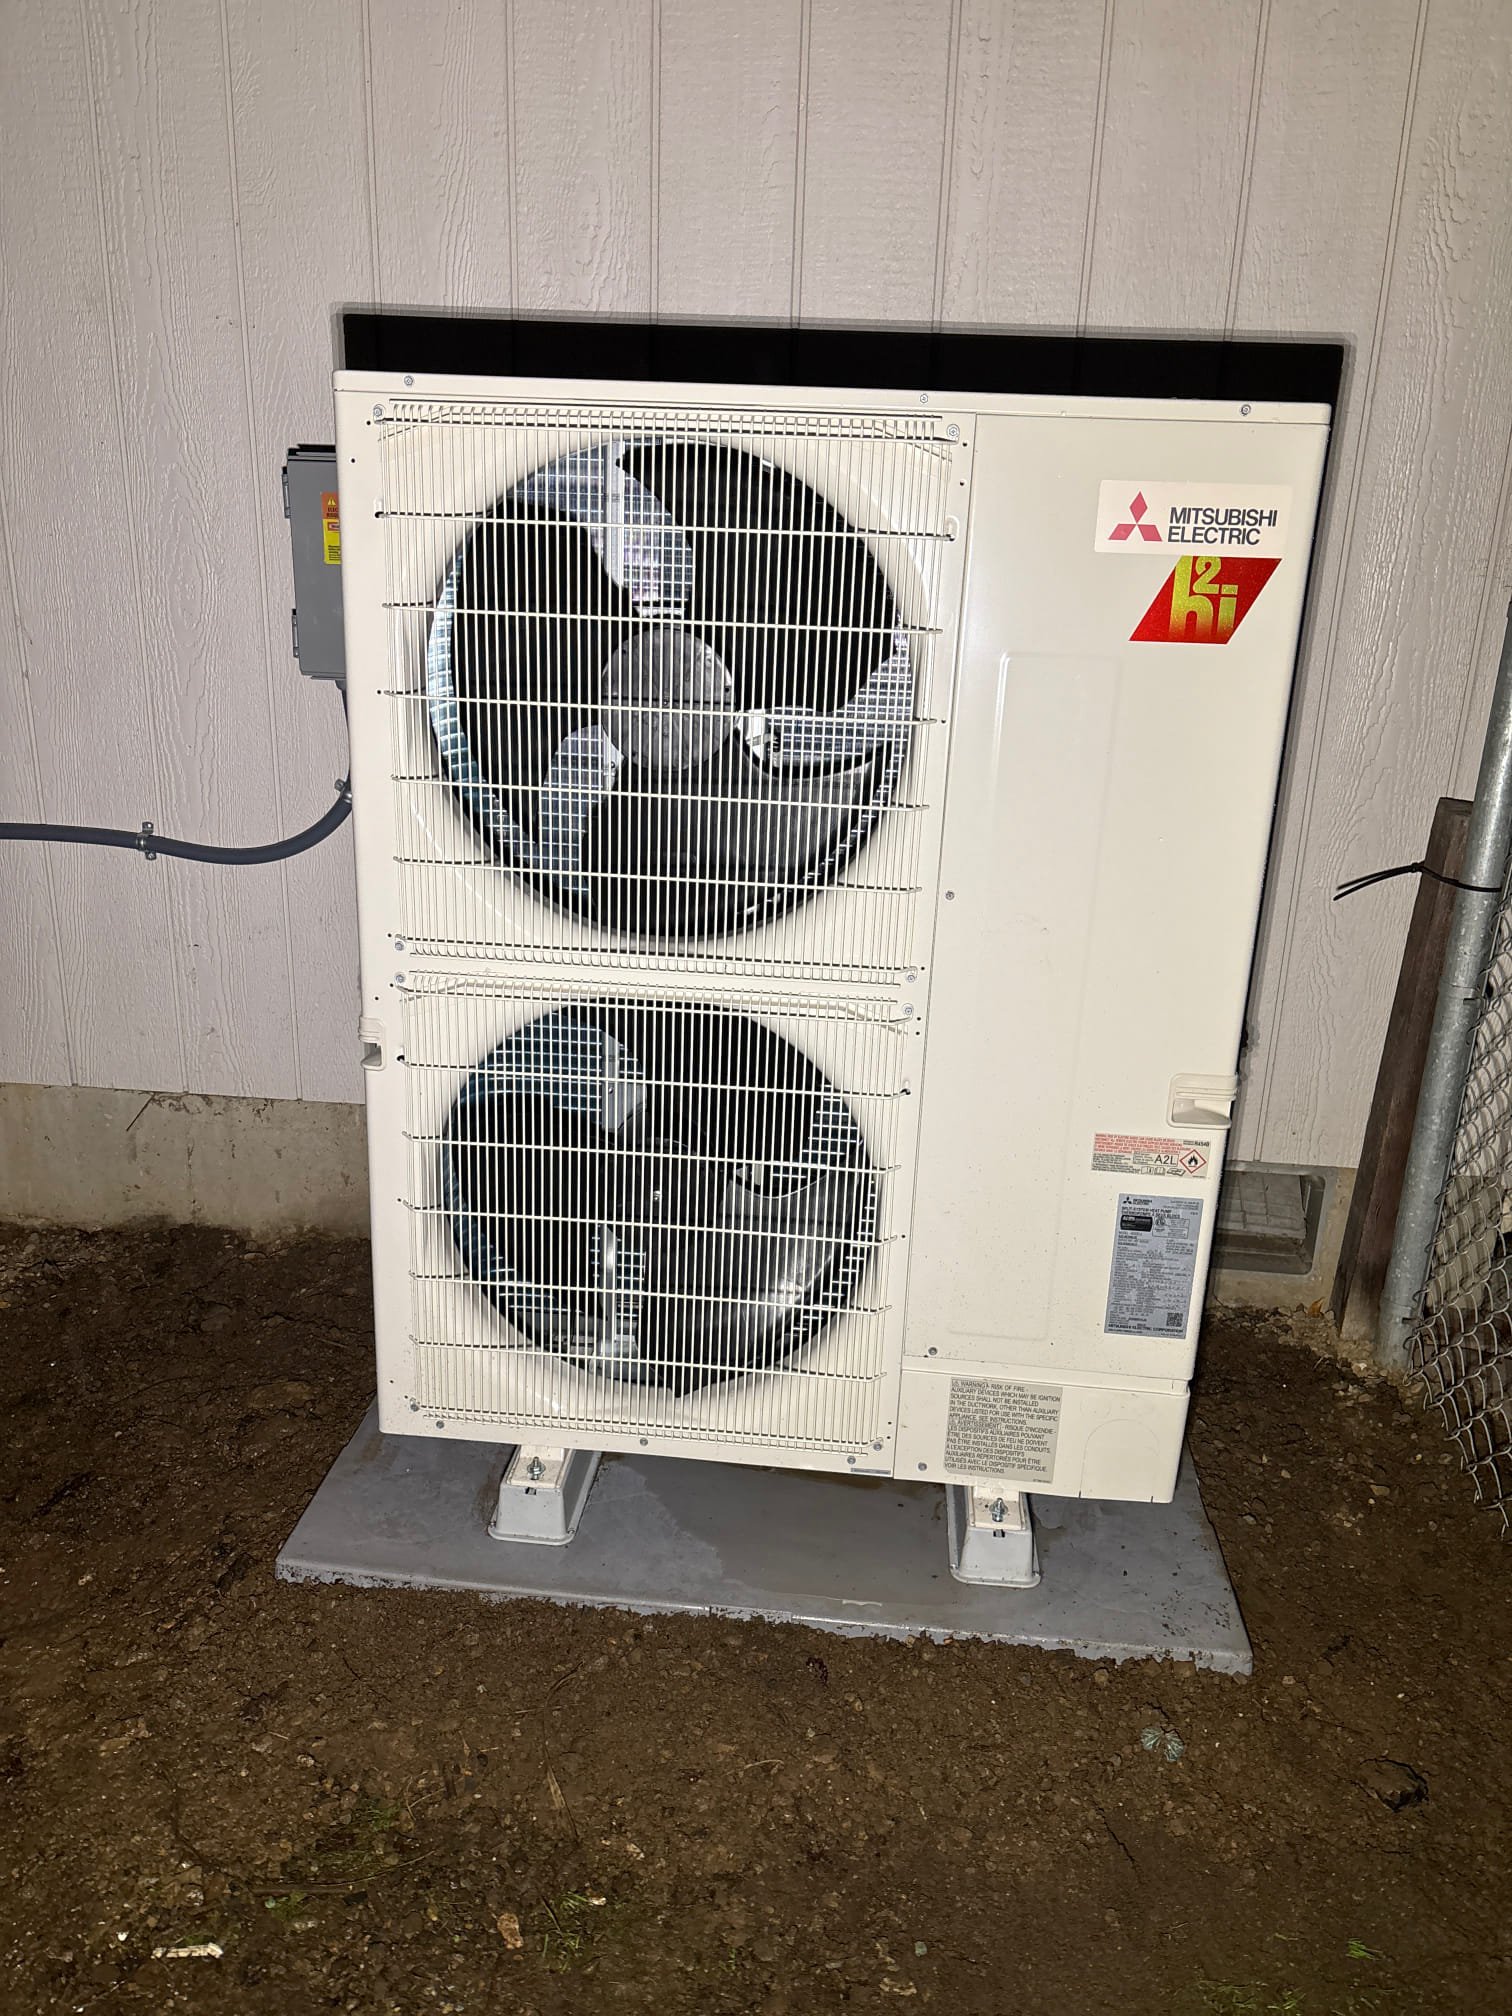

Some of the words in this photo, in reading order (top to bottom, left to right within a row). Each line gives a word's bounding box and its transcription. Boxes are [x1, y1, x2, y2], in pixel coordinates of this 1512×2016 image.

[1170, 507, 1278, 527] MITSUBISHI
[1168, 526, 1260, 545] ELECTRIC
[1154, 1155, 1176, 1165] A2L
